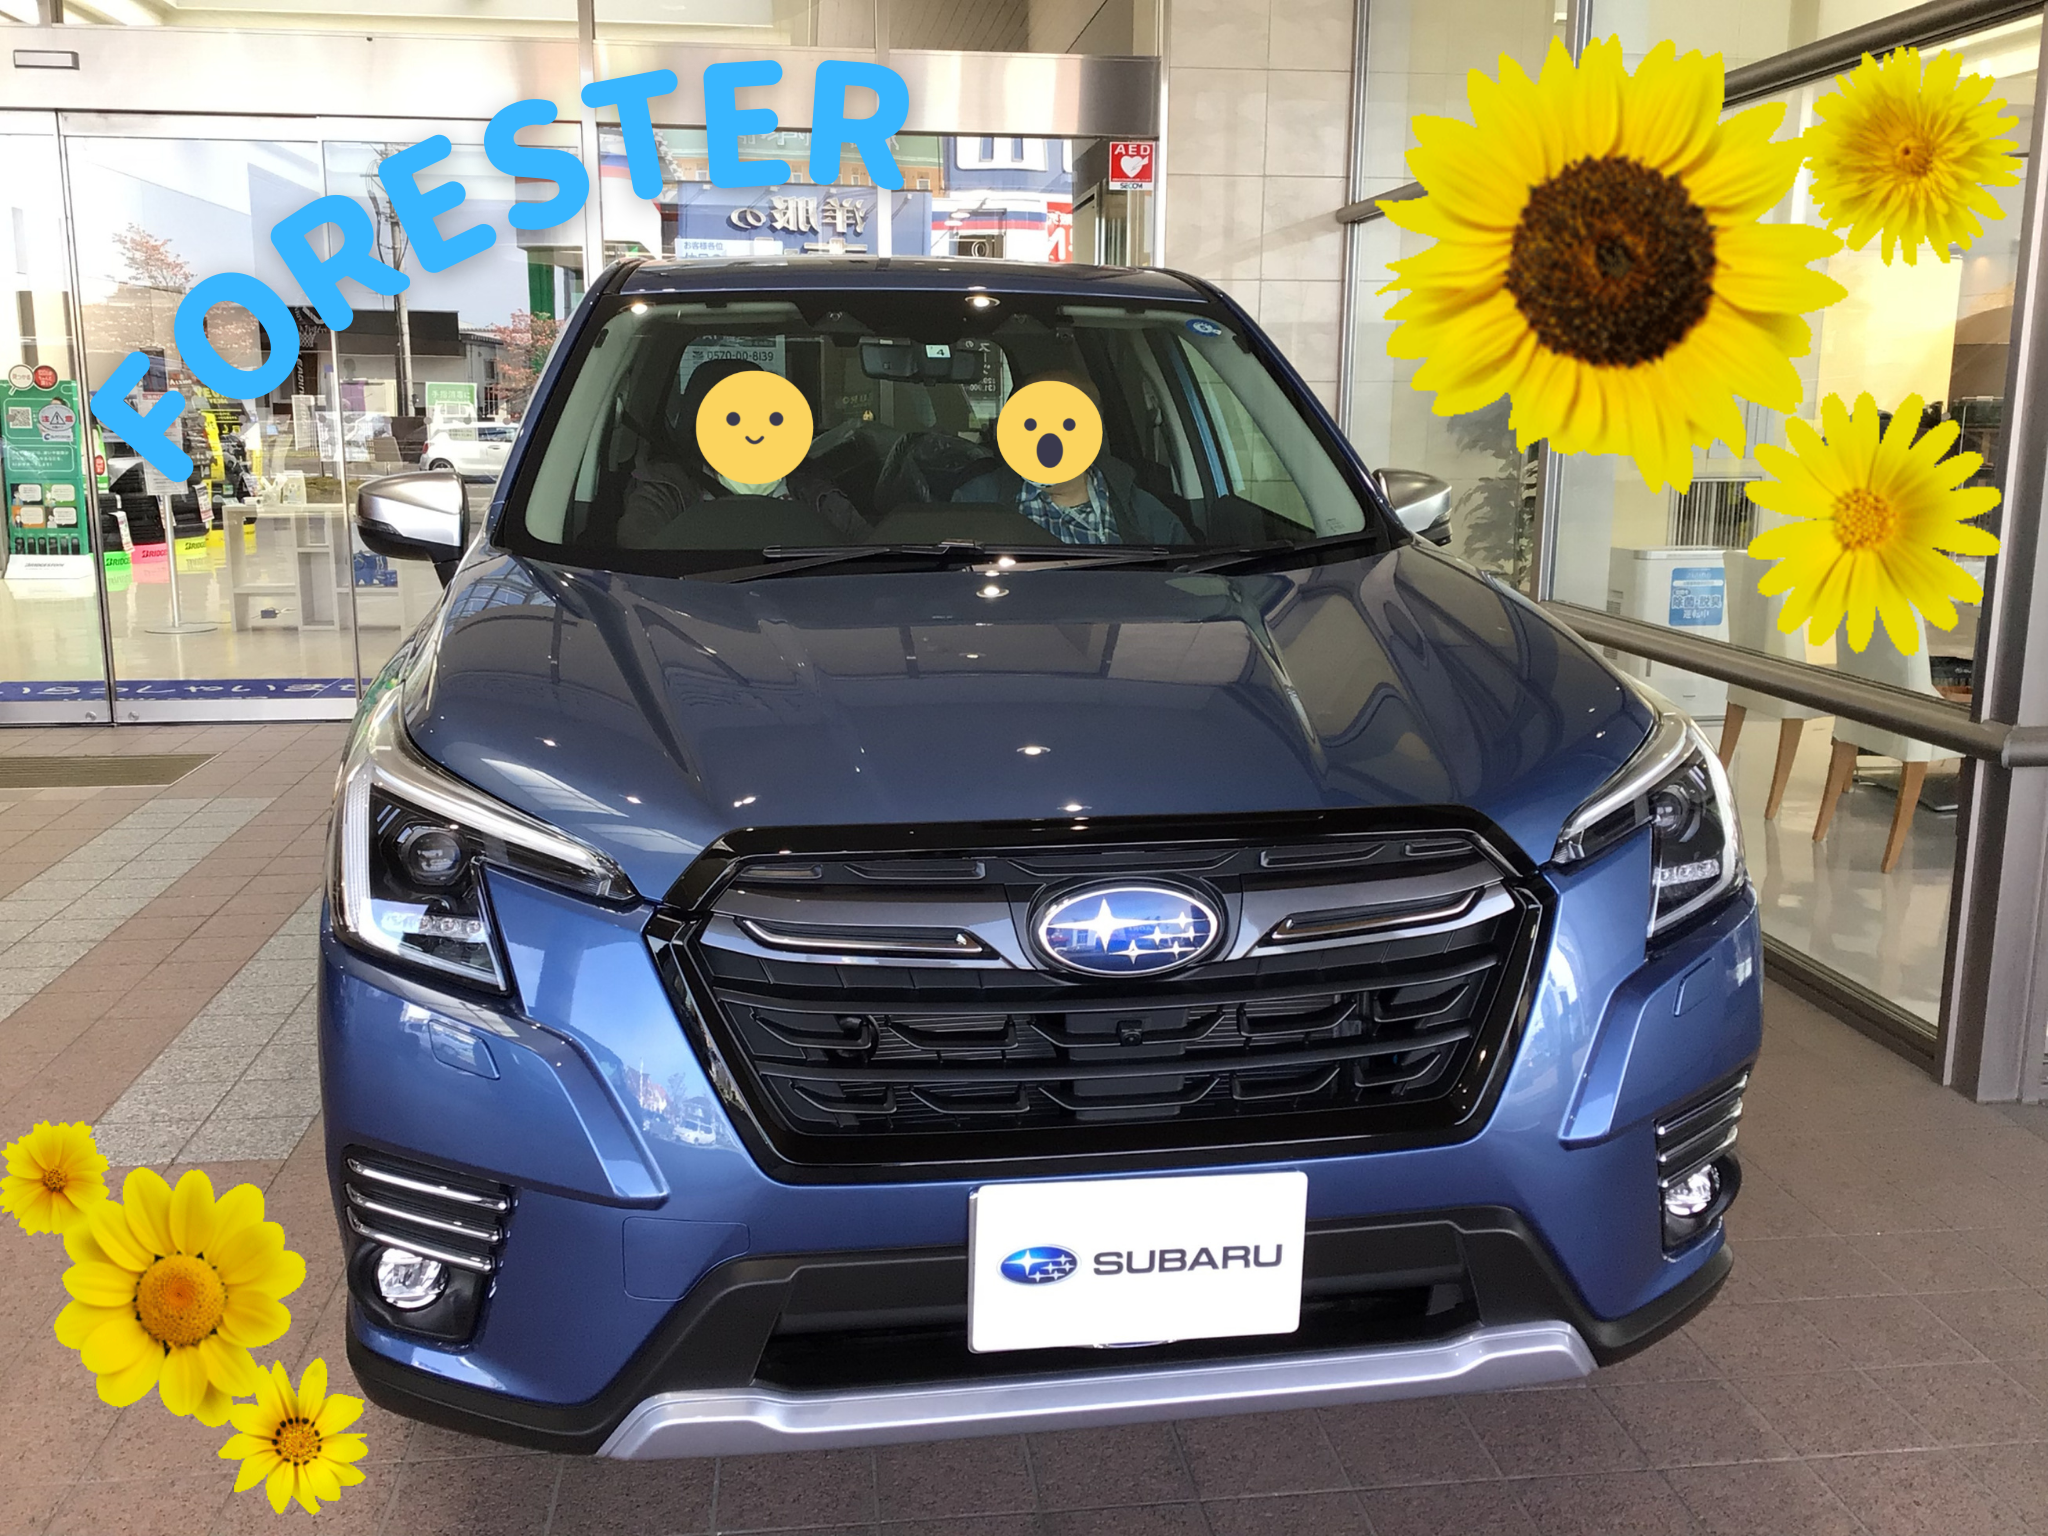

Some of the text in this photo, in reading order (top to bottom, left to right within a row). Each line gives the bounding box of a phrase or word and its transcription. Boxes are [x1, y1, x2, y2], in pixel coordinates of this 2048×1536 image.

[1114, 144, 1151, 155] AED
[683, 241, 724, 250] お客様各位
[1093, 1244, 1283, 1275] SUBARU
